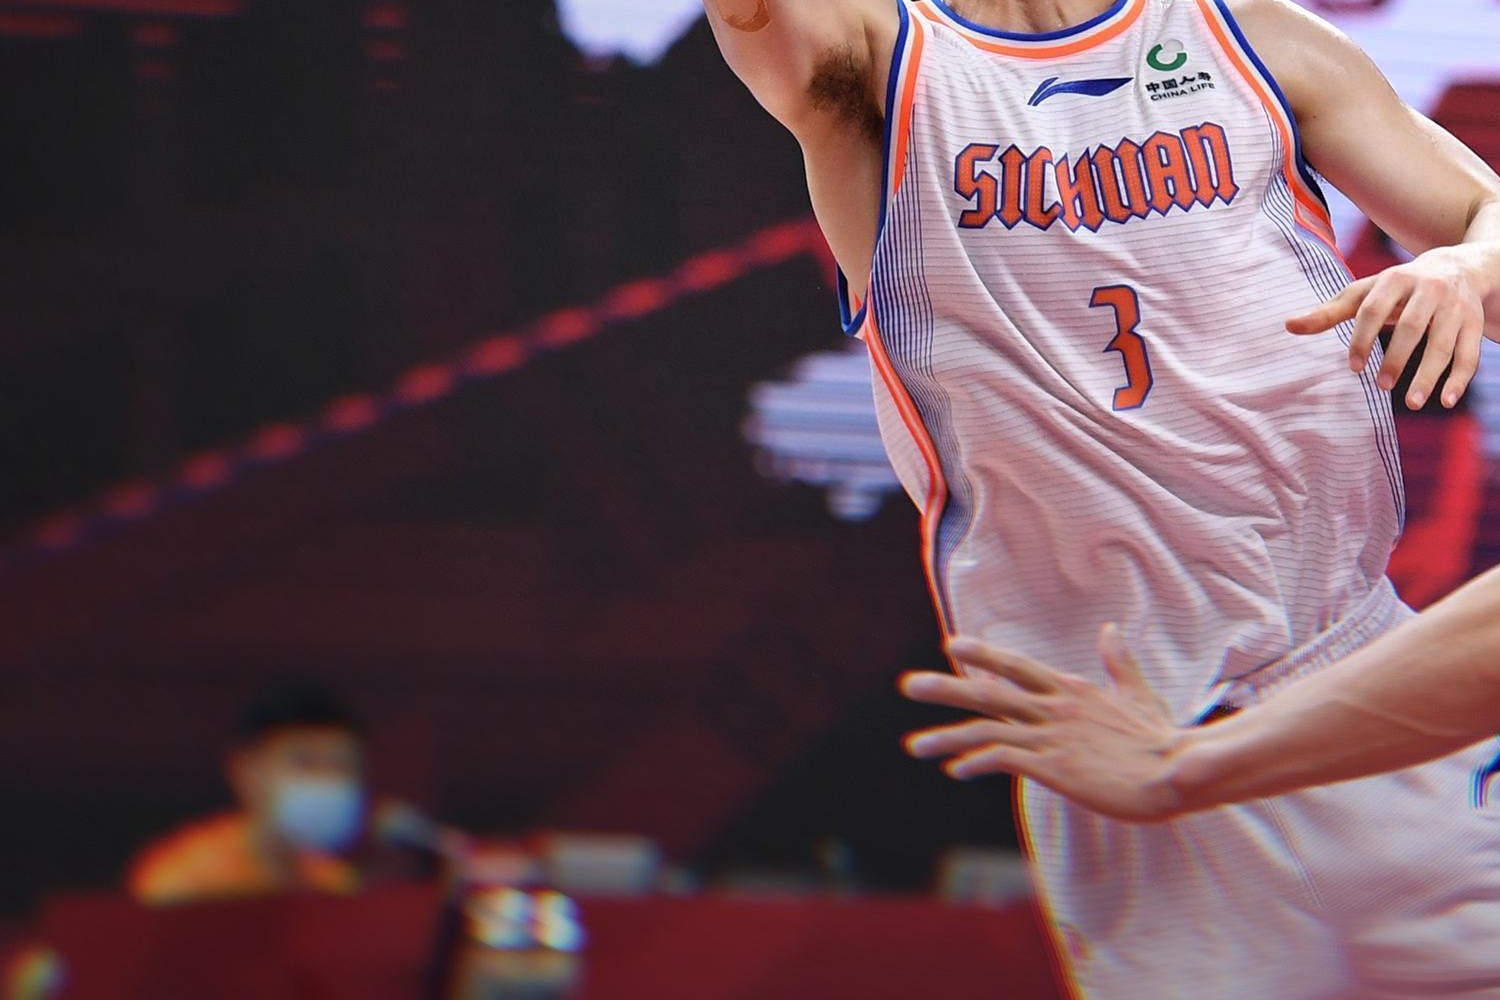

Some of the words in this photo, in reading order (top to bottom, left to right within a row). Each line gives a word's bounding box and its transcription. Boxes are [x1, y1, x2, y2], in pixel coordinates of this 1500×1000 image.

[1150, 89, 1188, 101] CHINA
[1190, 82, 1215, 92] LIFE
[955, 121, 1239, 232] SICHUAN
[1089, 284, 1153, 411] 3
